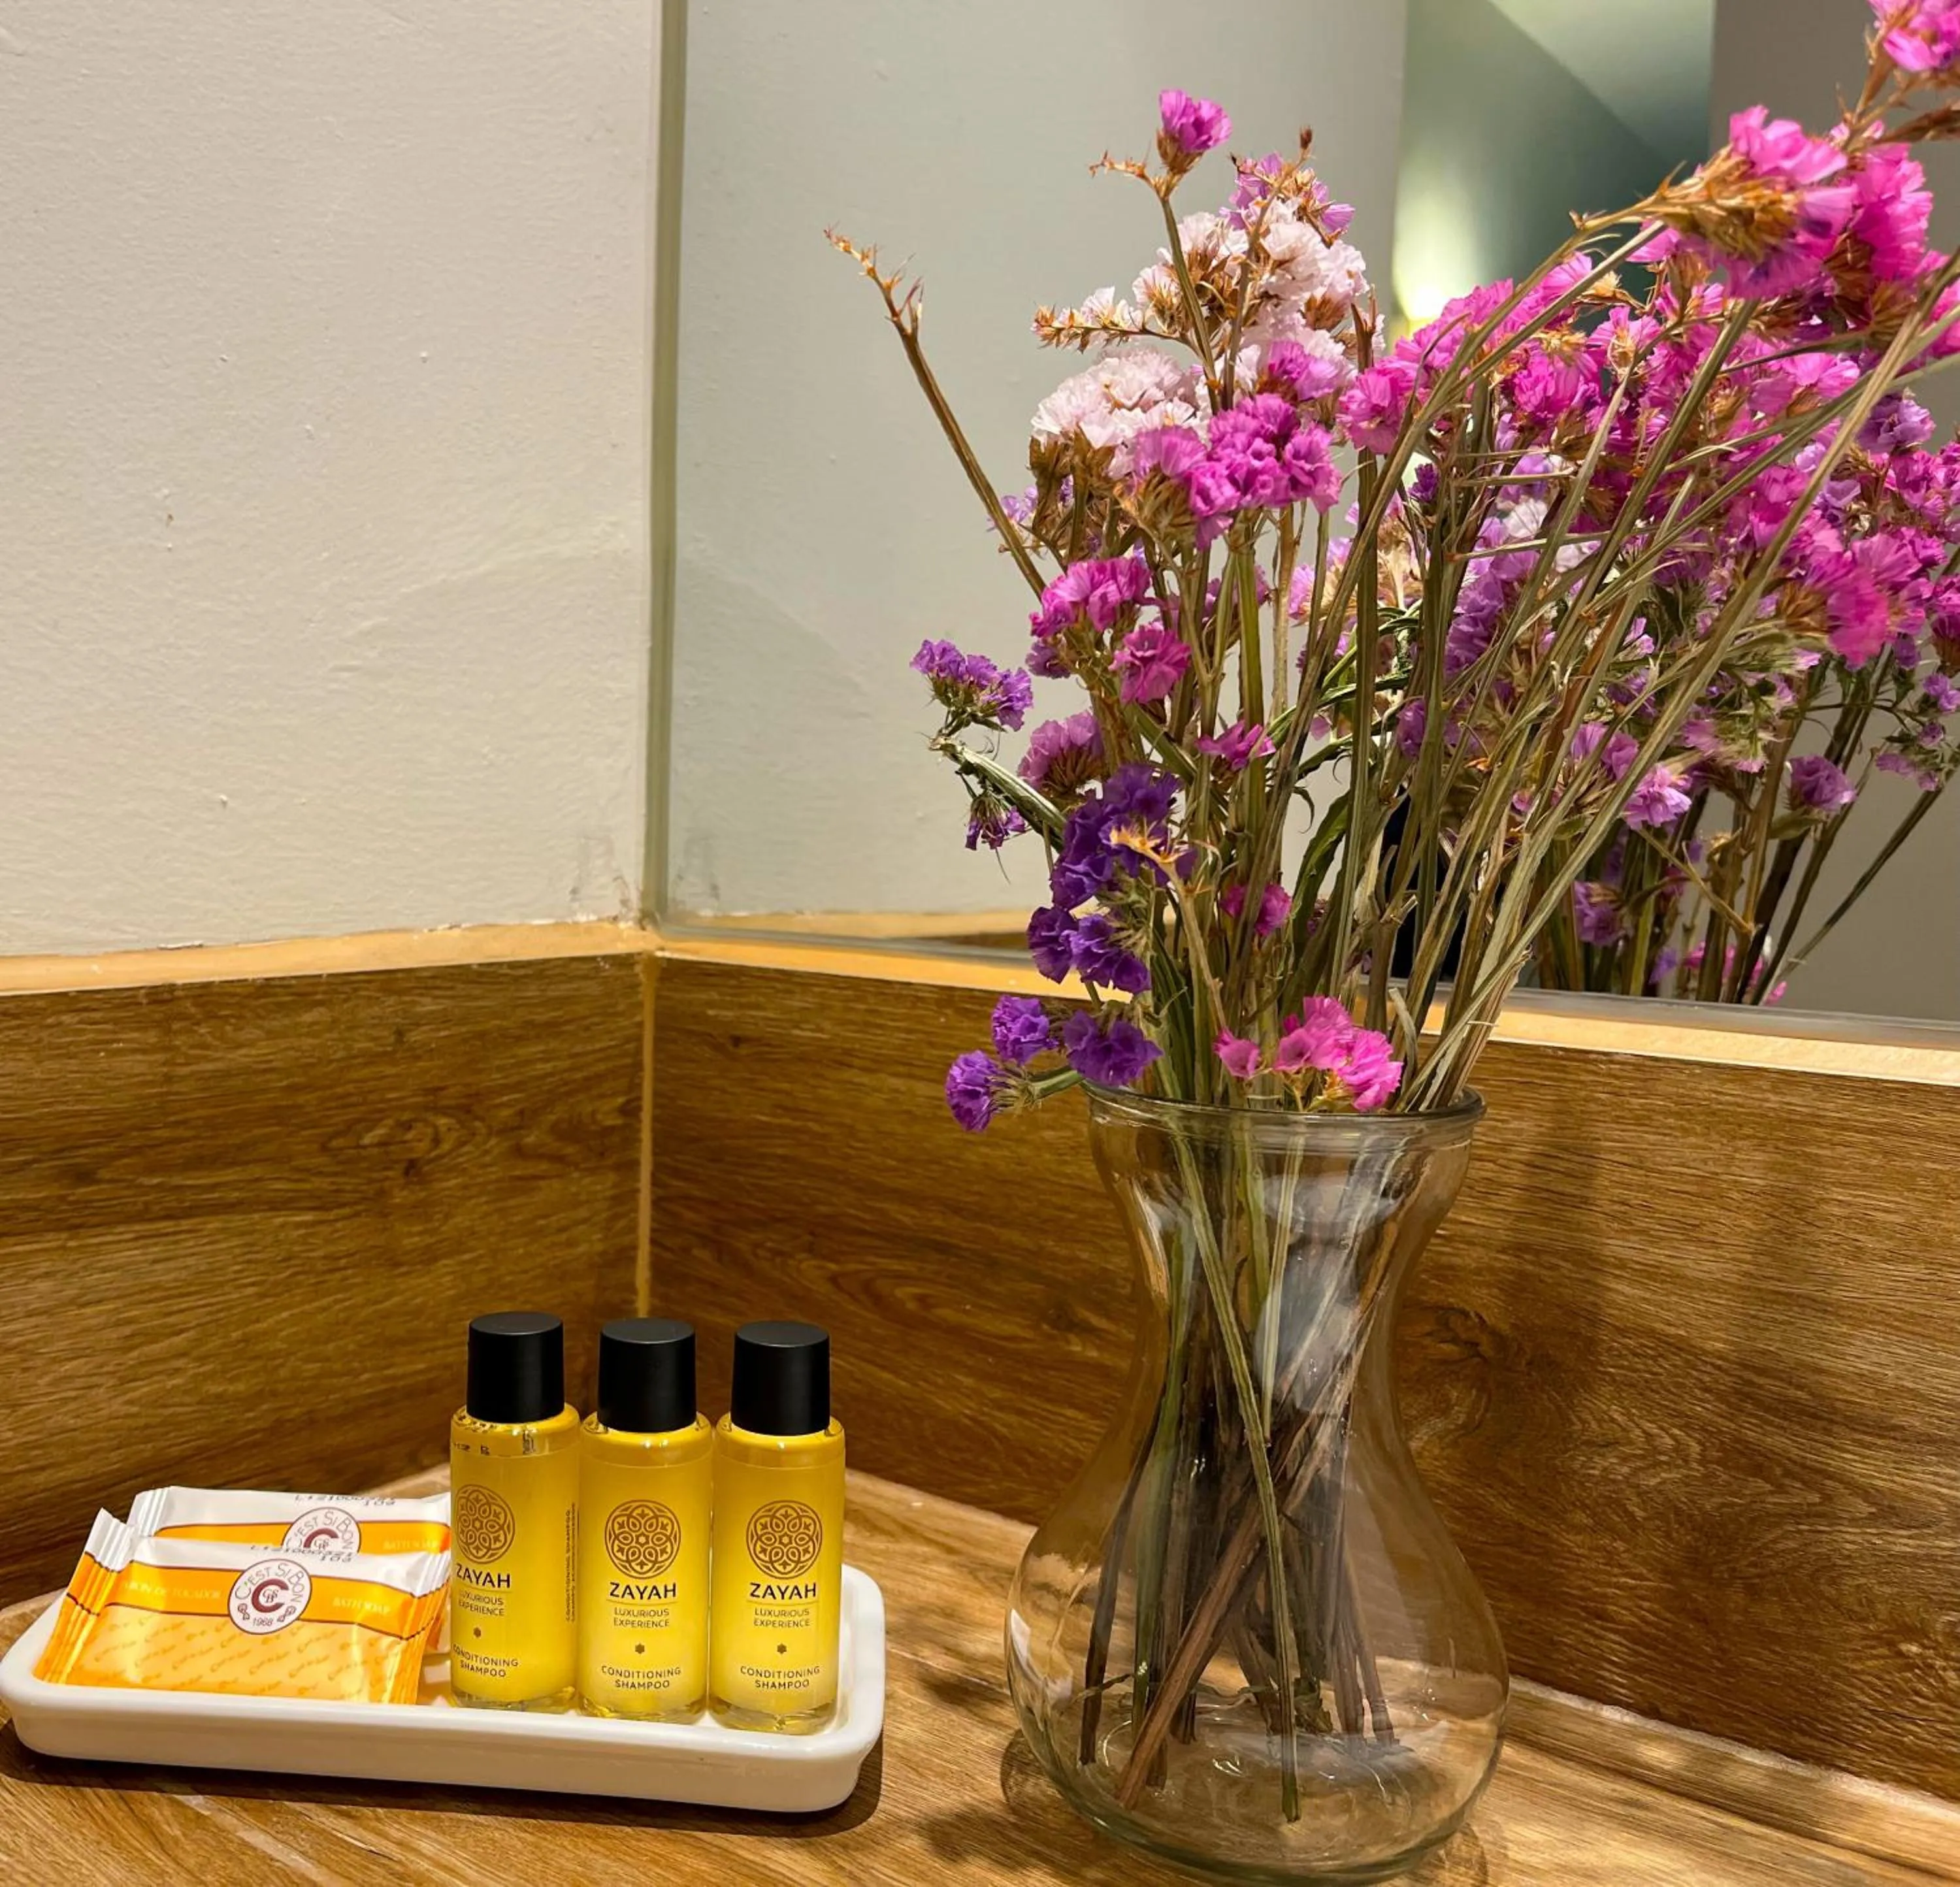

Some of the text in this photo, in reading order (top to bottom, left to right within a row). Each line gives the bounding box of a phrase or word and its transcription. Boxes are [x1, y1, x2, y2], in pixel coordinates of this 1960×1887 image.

[456, 1563, 511, 1588] ZAYAH
[275, 1563, 291, 1577] SI
[288, 1571, 304, 1603] BON
[610, 1582, 676, 1600] ZAYAH
[749, 1582, 816, 1600] ZAYAH
[614, 1607, 670, 1618] LUXURIOUS
[755, 1607, 809, 1618] LUXURIOUS
[613, 1618, 670, 1628] EXPERIENCE
[753, 1618, 811, 1628] EXPERIENCE
[460, 1660, 506, 1678] SHAMPOO
[601, 1665, 681, 1679] CONDITIONING
[740, 1665, 821, 1679] CONDITIONING
[615, 1679, 670, 1690] SHAMPOO
[755, 1679, 810, 1690] SHAMPOO
